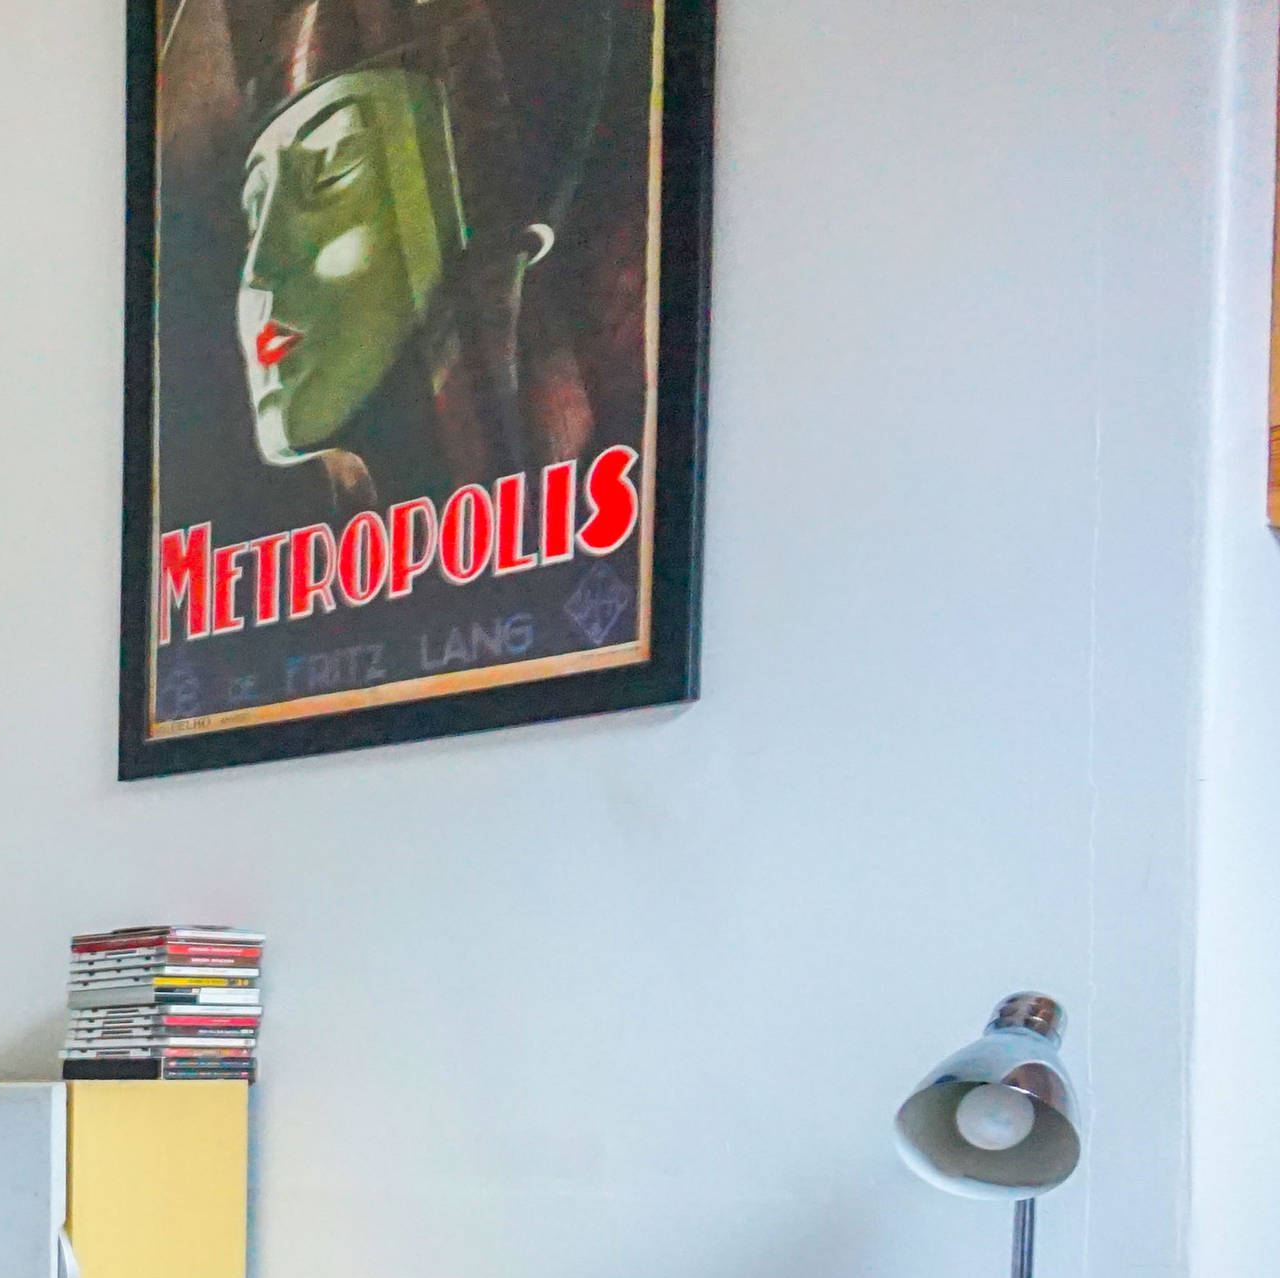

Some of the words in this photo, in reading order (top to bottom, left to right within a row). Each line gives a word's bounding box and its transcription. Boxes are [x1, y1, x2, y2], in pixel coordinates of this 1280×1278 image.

[158, 444, 639, 646] METROPOLIS
[285, 644, 388, 699] FRITZ
[421, 612, 535, 672] LANG
